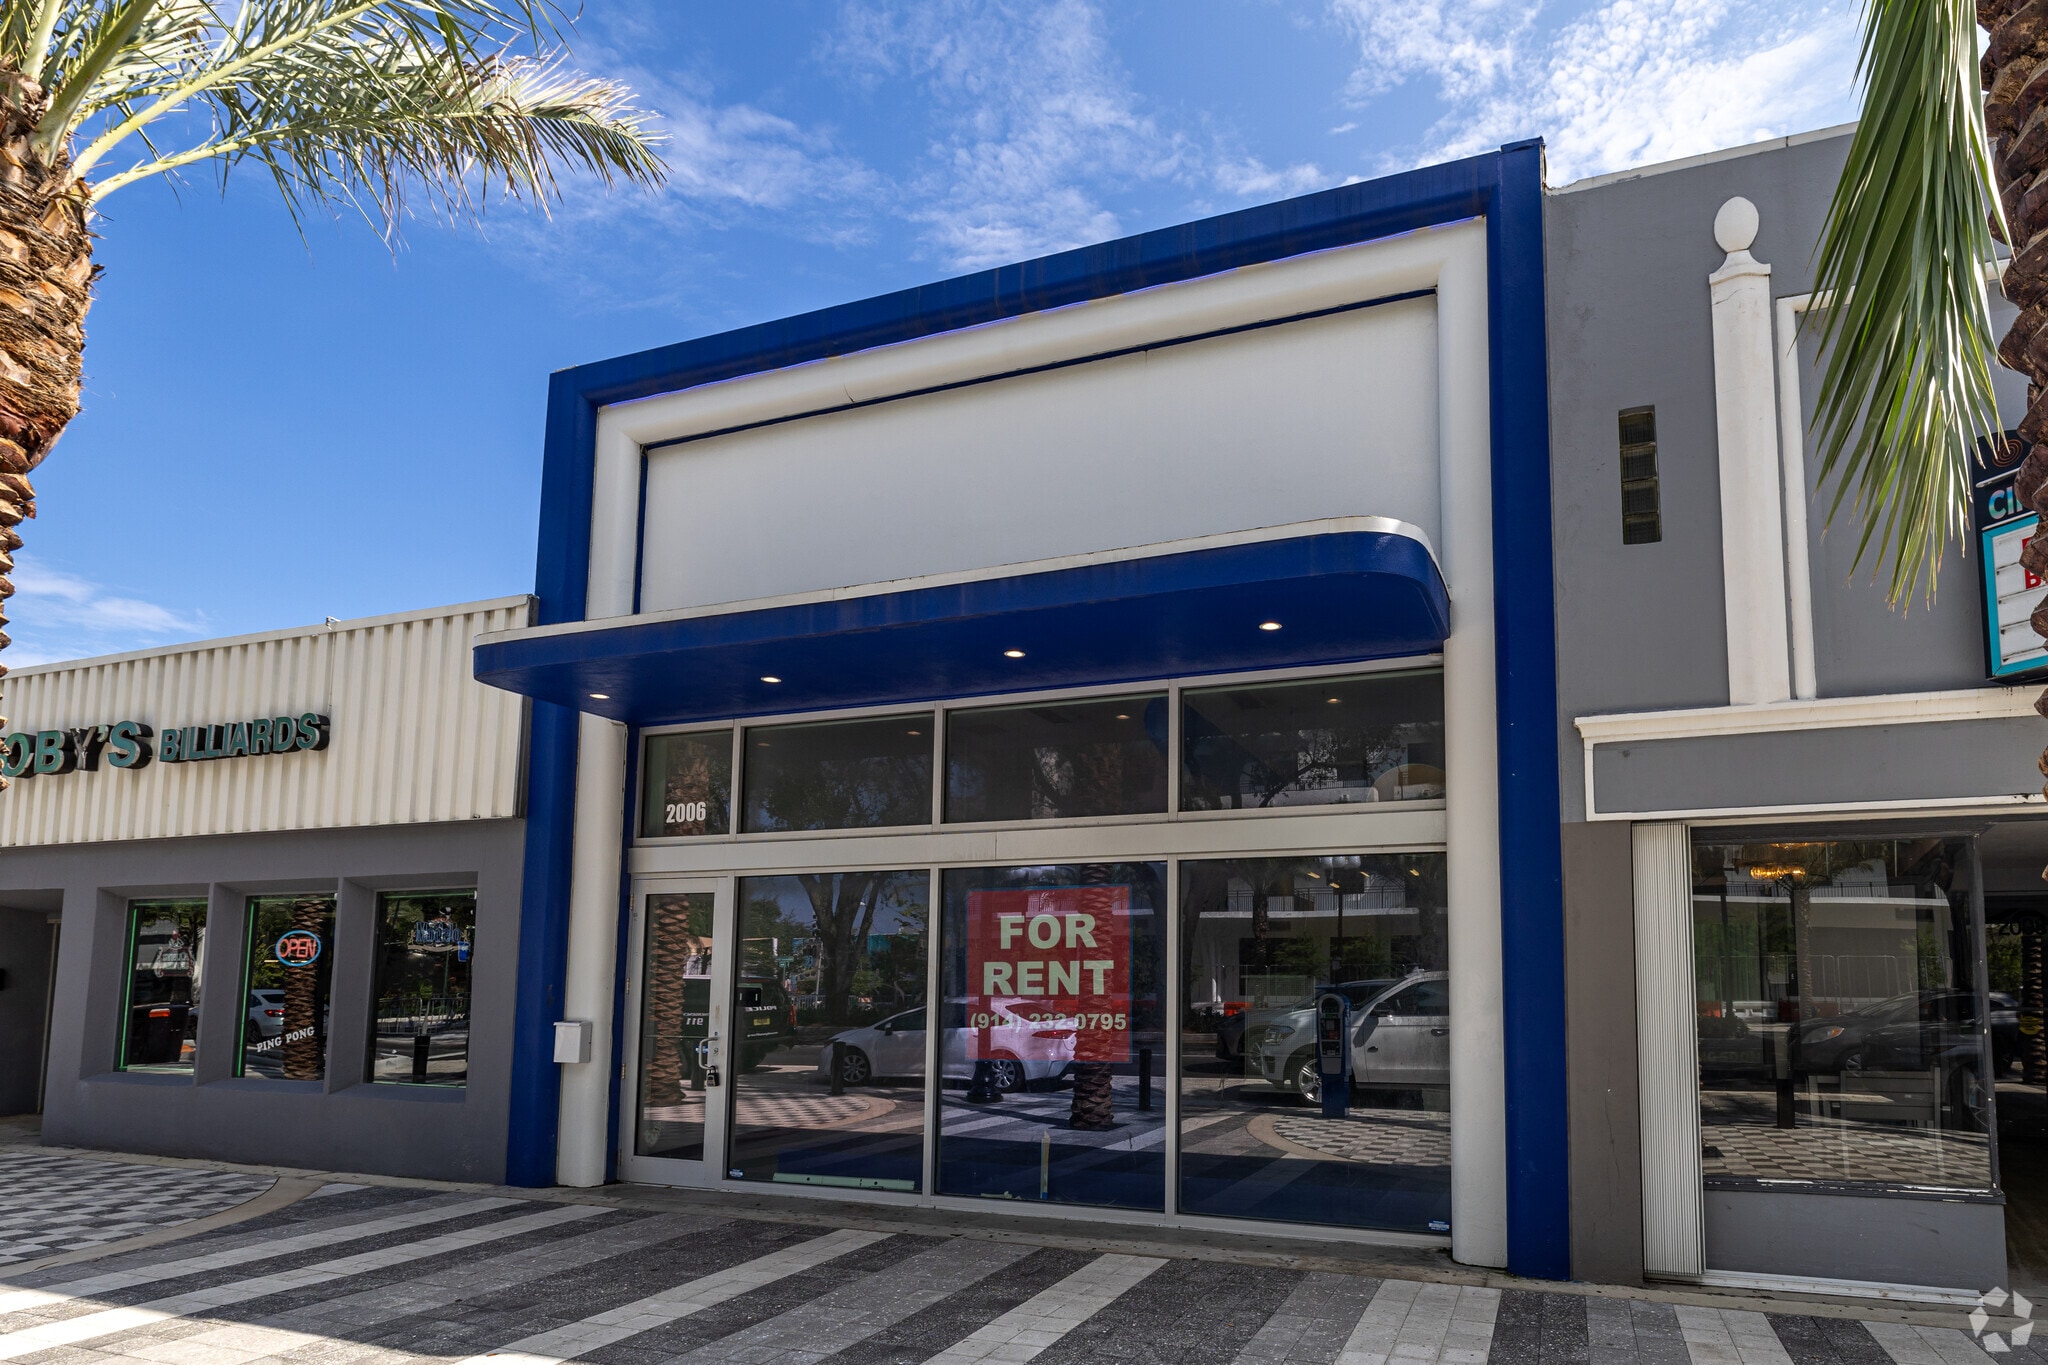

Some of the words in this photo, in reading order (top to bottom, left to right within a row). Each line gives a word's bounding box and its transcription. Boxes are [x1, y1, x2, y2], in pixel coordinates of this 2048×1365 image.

[159, 712, 330, 763] BILLIARDS
[666, 801, 707, 824] 2006
[1000, 913, 1098, 950] FOR
[278, 938, 317, 958] OPEN
[983, 959, 1115, 996] RENT
[256, 1036, 282, 1053] PING
[285, 1026, 315, 1044] PONG
